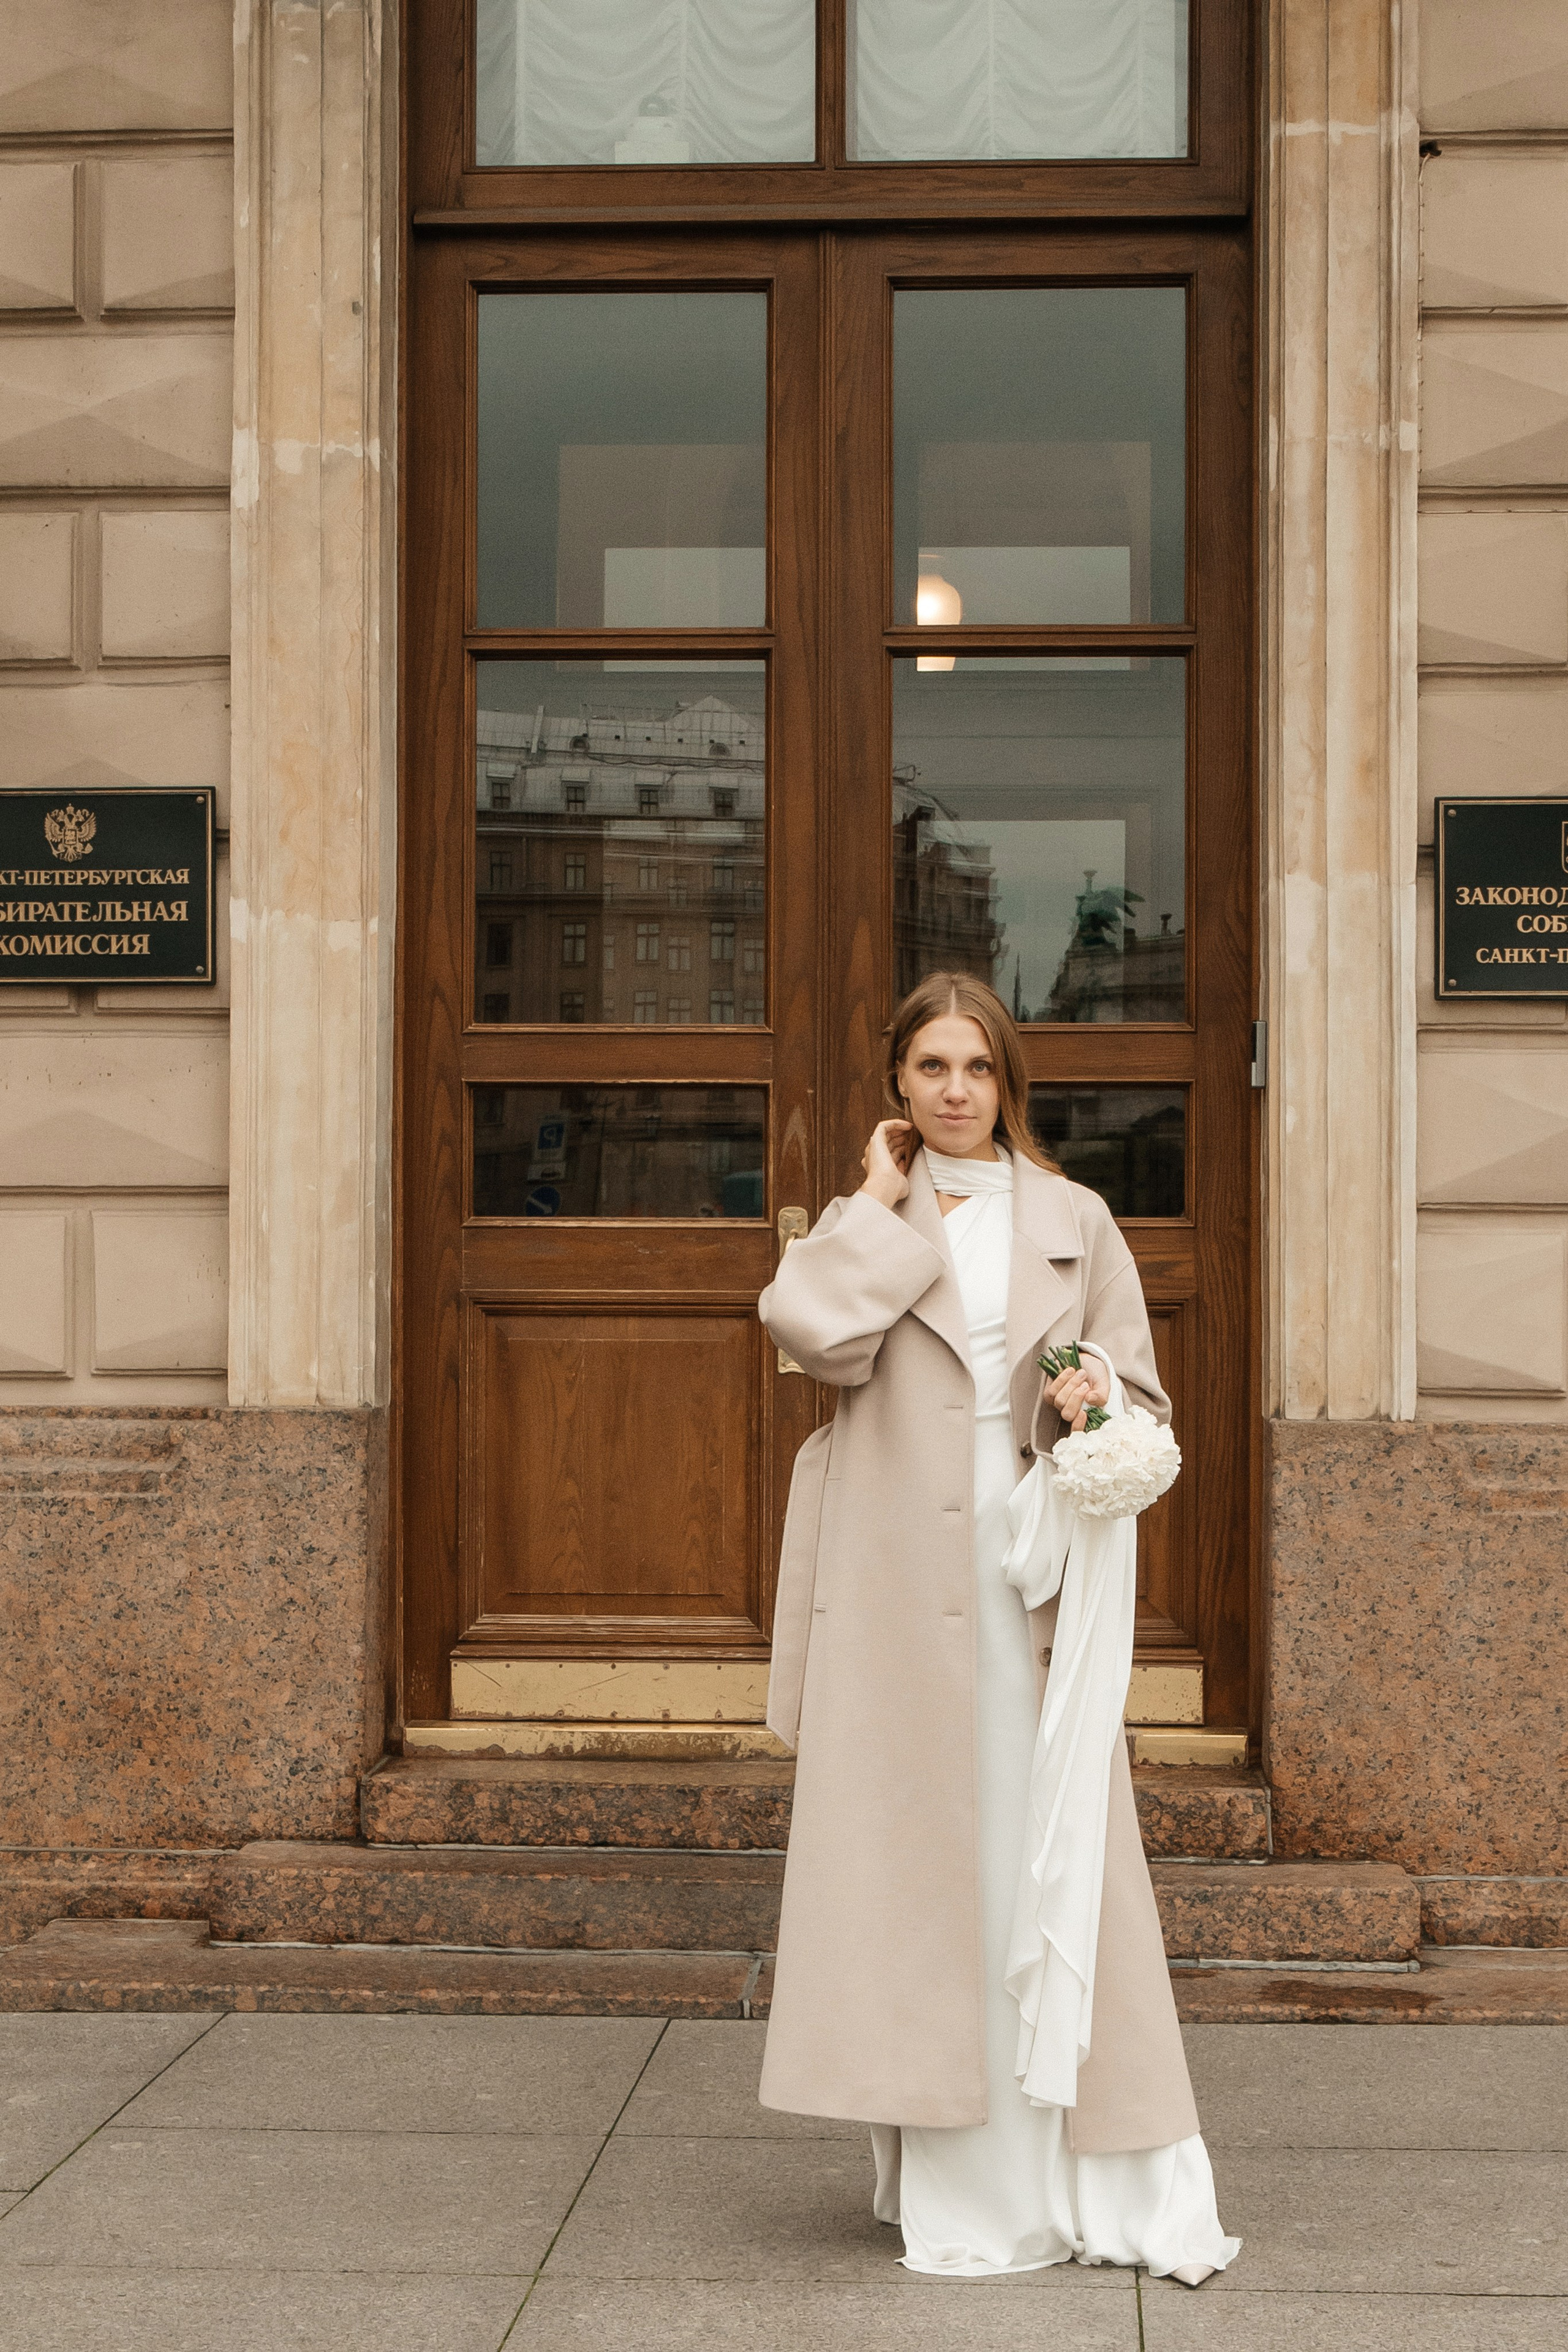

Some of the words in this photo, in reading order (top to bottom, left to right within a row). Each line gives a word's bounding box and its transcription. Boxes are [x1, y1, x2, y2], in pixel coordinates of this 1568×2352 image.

[1517, 915, 1568, 933] СОБ
[0, 934, 151, 956] КОМИССИЯ
[1476, 948, 1568, 964] САНКТ-П
